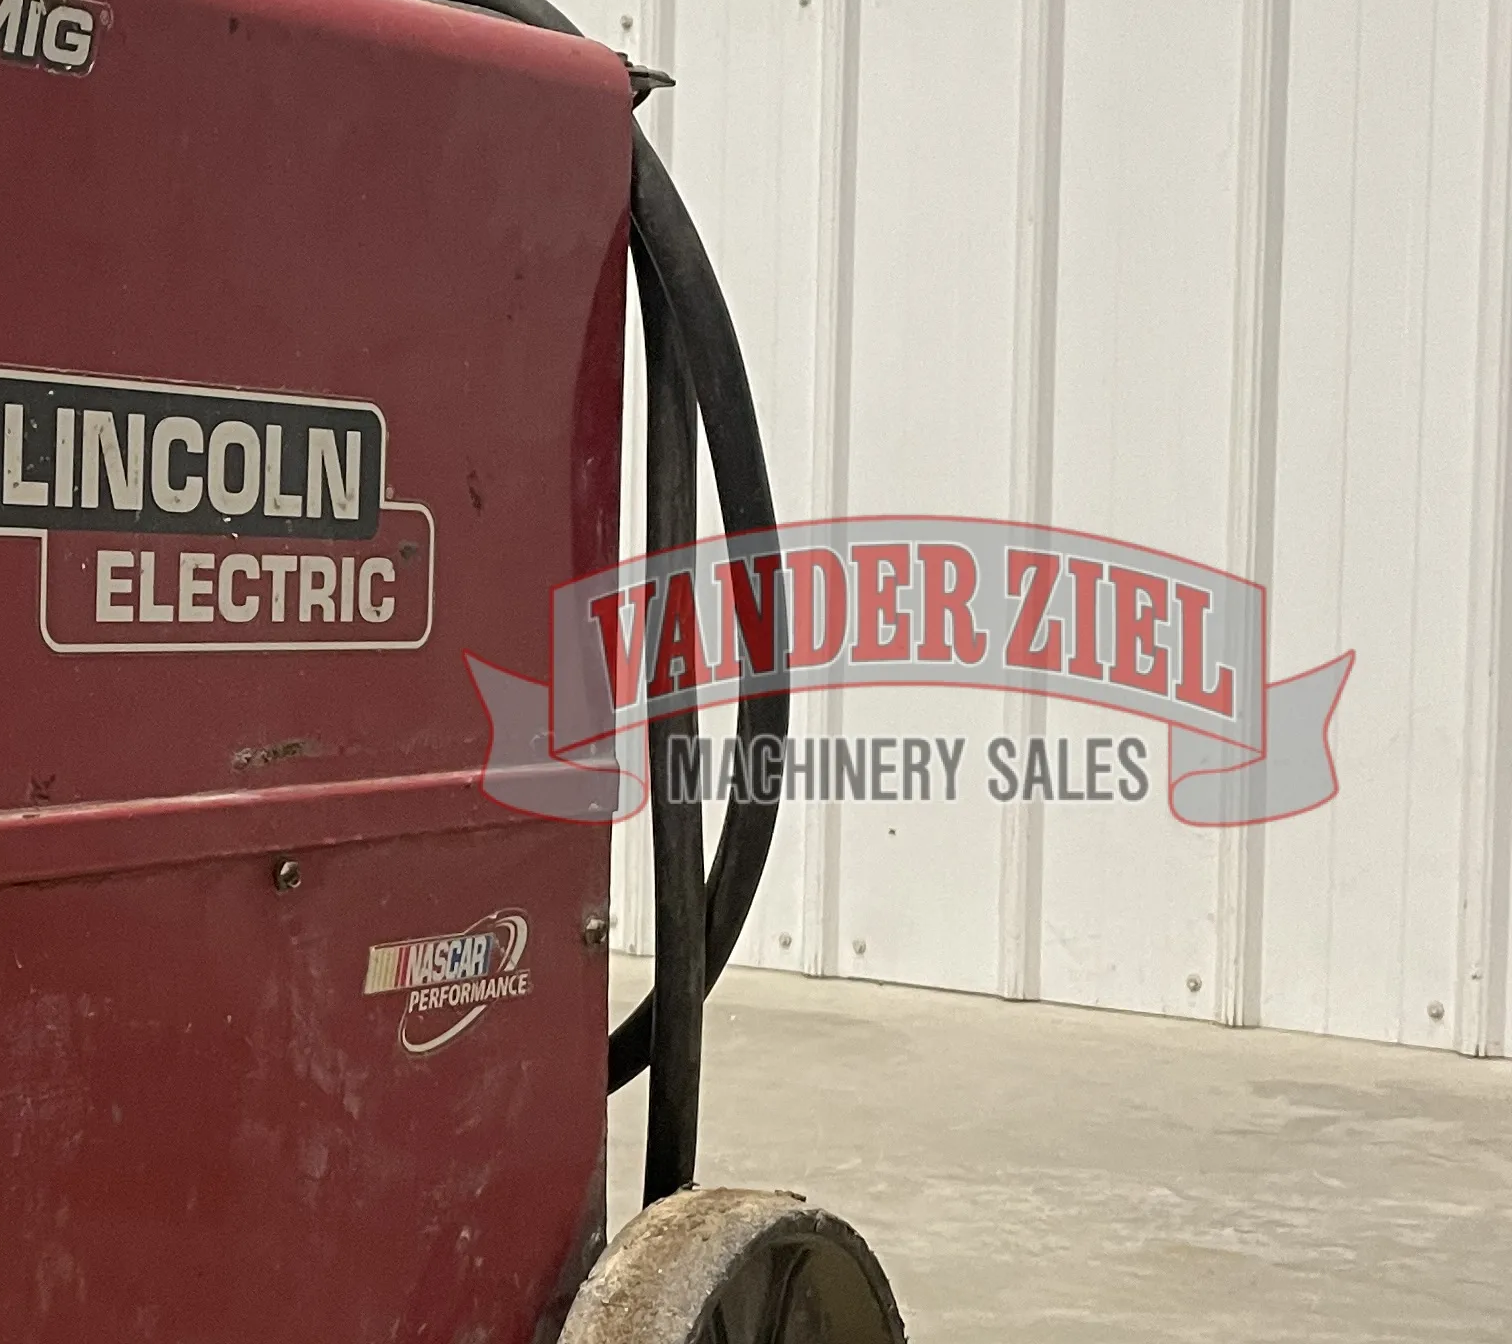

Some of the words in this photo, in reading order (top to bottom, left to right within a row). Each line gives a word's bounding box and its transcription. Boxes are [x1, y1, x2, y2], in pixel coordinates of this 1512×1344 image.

[2, 402, 362, 520] LINCOLN
[95, 549, 396, 623] ELECTRIC
[407, 935, 488, 986] NASCAR
[408, 973, 529, 1014] PERFORMANCE
